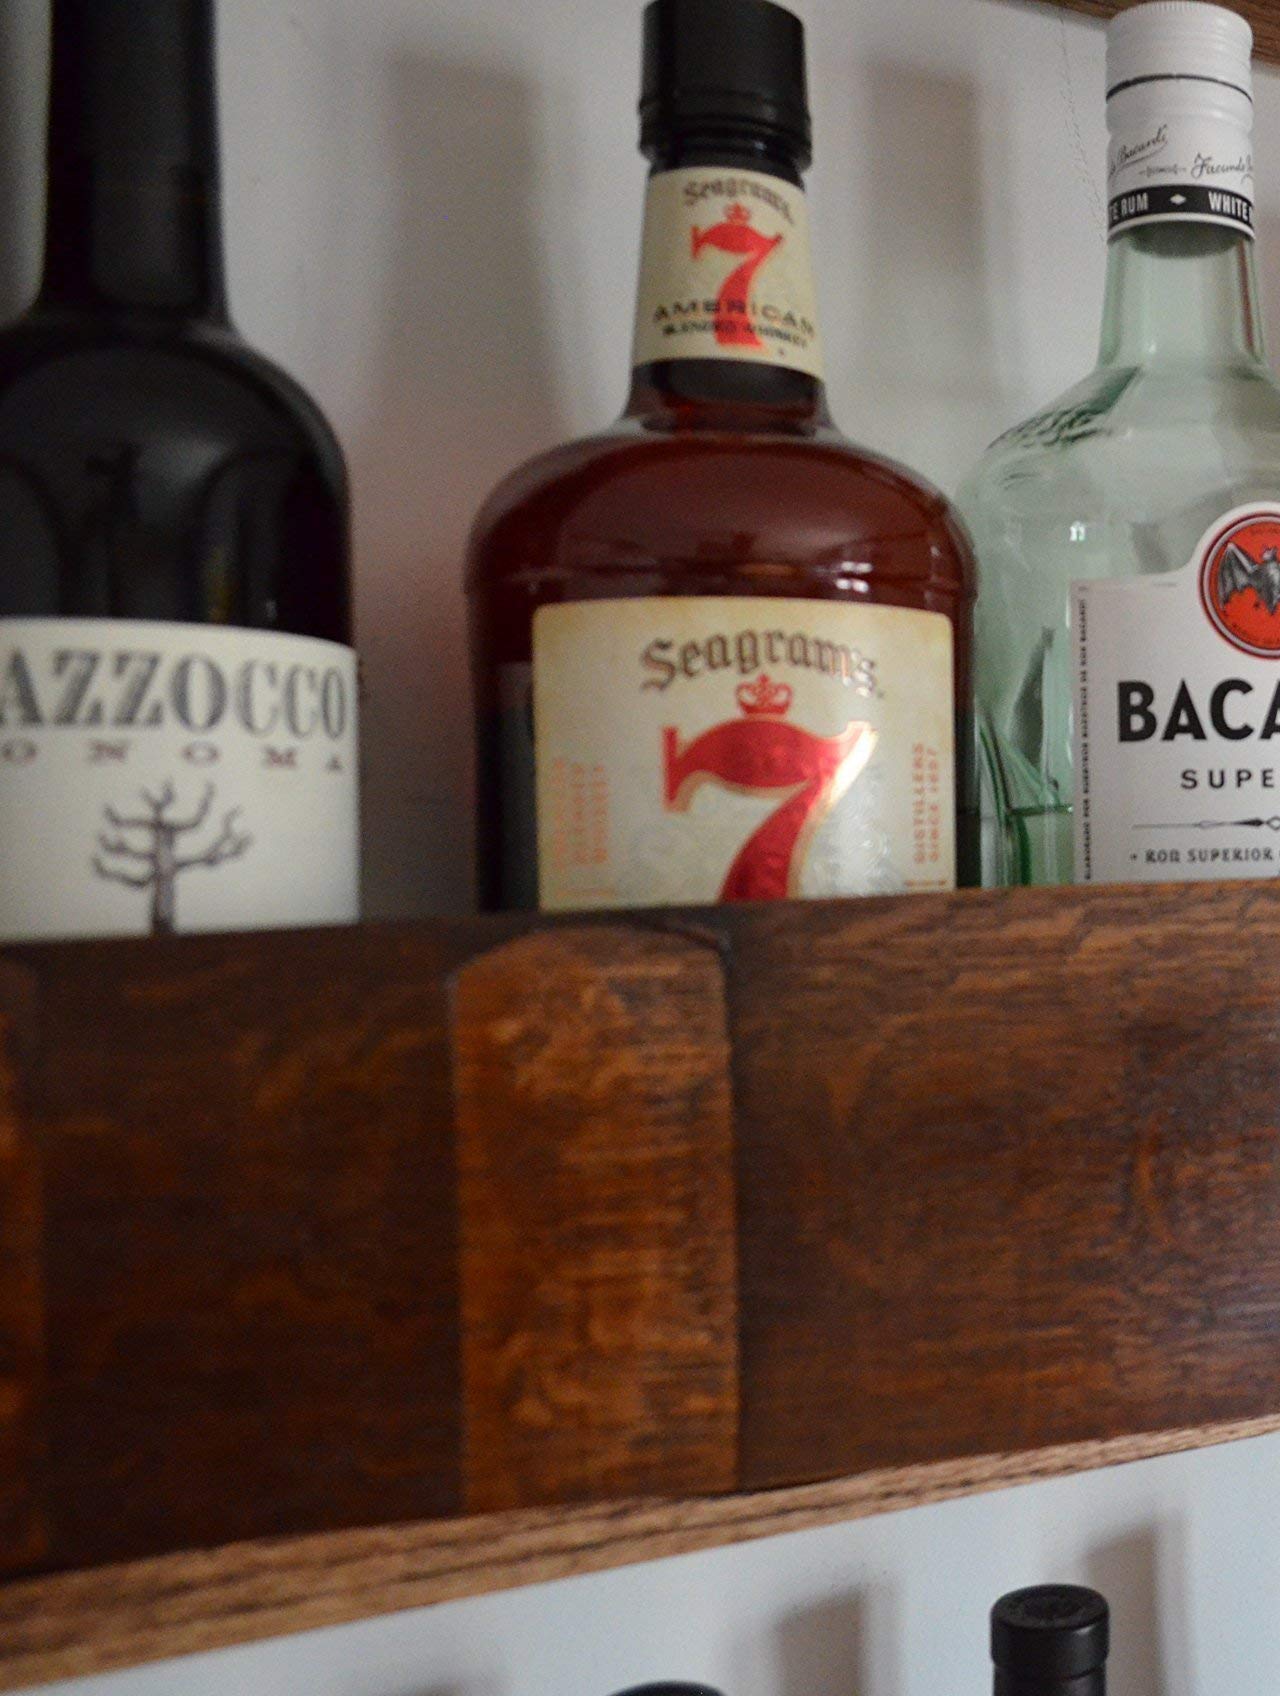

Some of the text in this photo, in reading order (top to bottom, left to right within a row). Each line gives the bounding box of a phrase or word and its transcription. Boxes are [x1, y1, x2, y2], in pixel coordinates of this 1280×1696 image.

[1120, 191, 1149, 218] RUM
[1208, 191, 1249, 220] WHITE
[691, 222, 783, 347] 7
[653, 300, 815, 336] AMERICAN
[662, 719, 878, 901] 7
[1186, 849, 1274, 863] SUPERIOR
